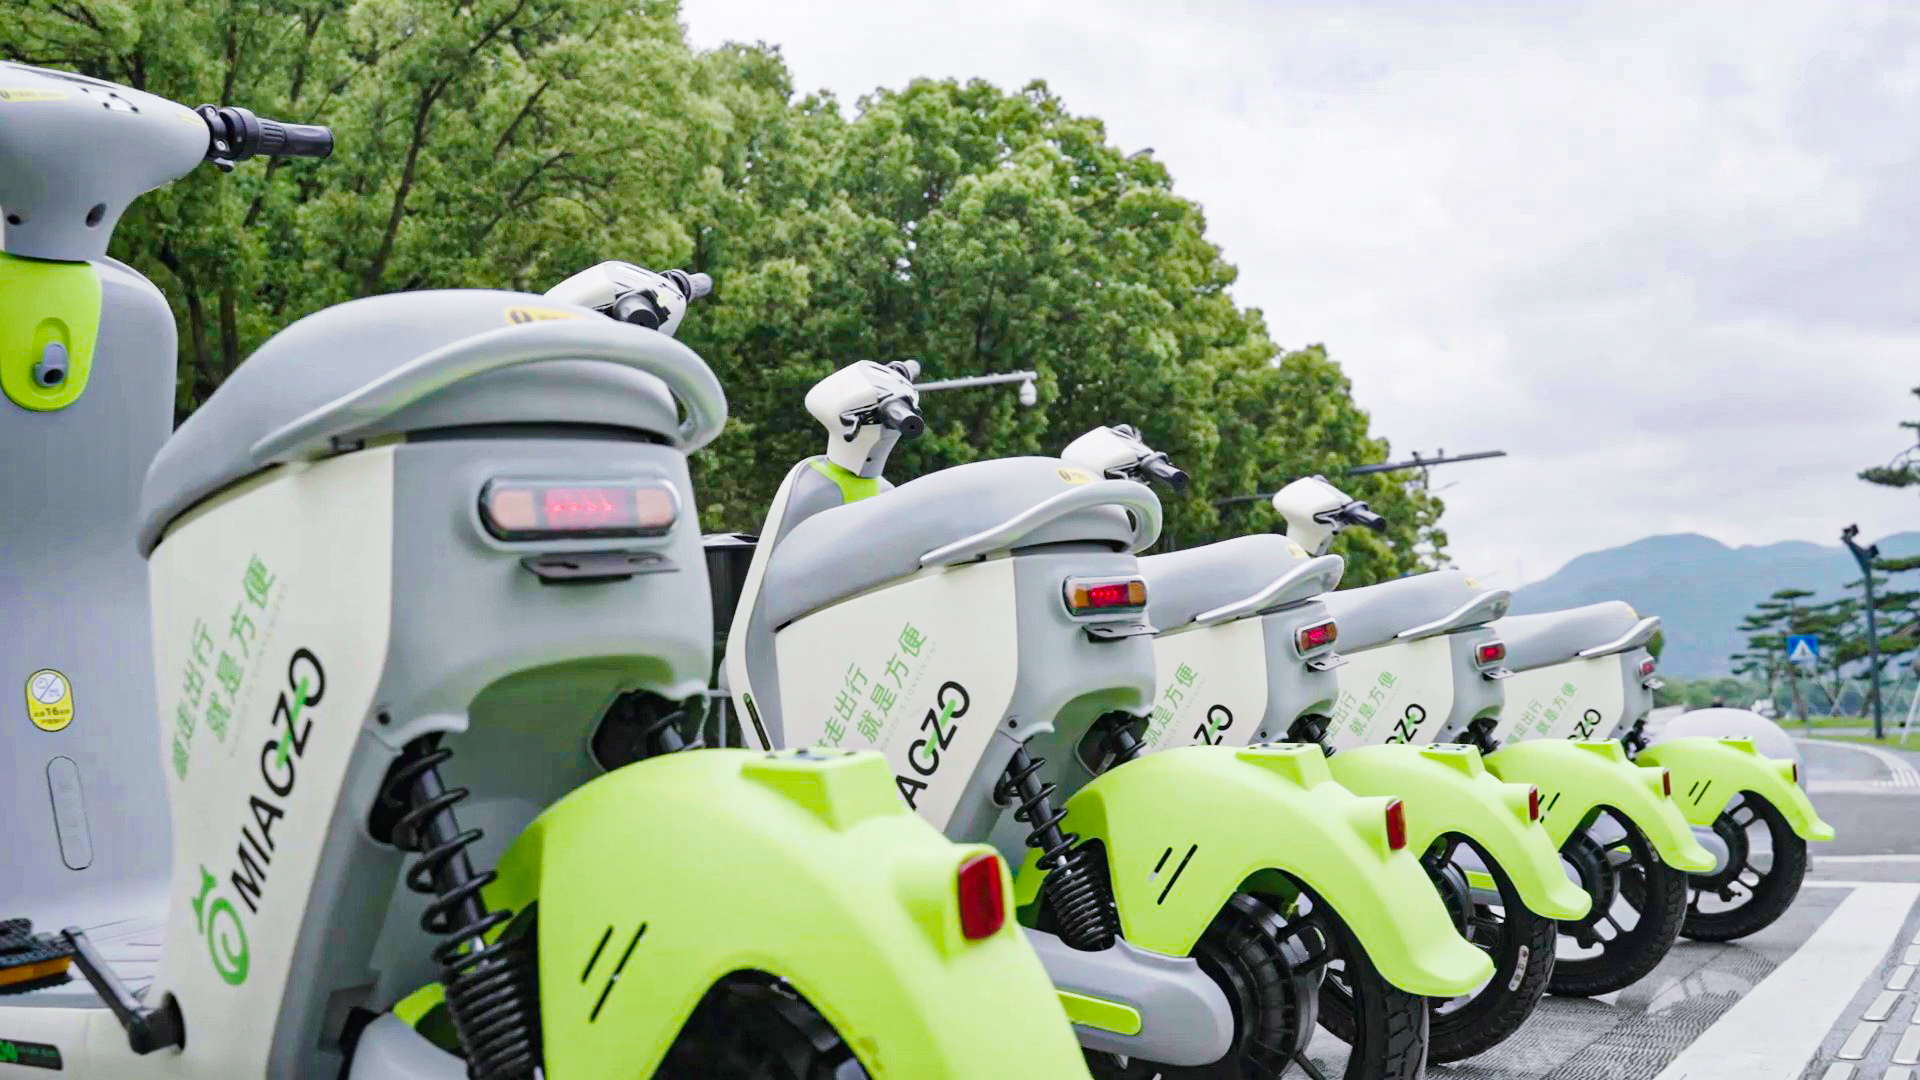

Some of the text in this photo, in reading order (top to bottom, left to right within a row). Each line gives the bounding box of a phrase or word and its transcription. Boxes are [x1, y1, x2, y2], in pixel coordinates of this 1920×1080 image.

[857, 621, 928, 745] 就是方便
[1142, 662, 1199, 749] 就是方便
[1349, 668, 1398, 738] 就是方便
